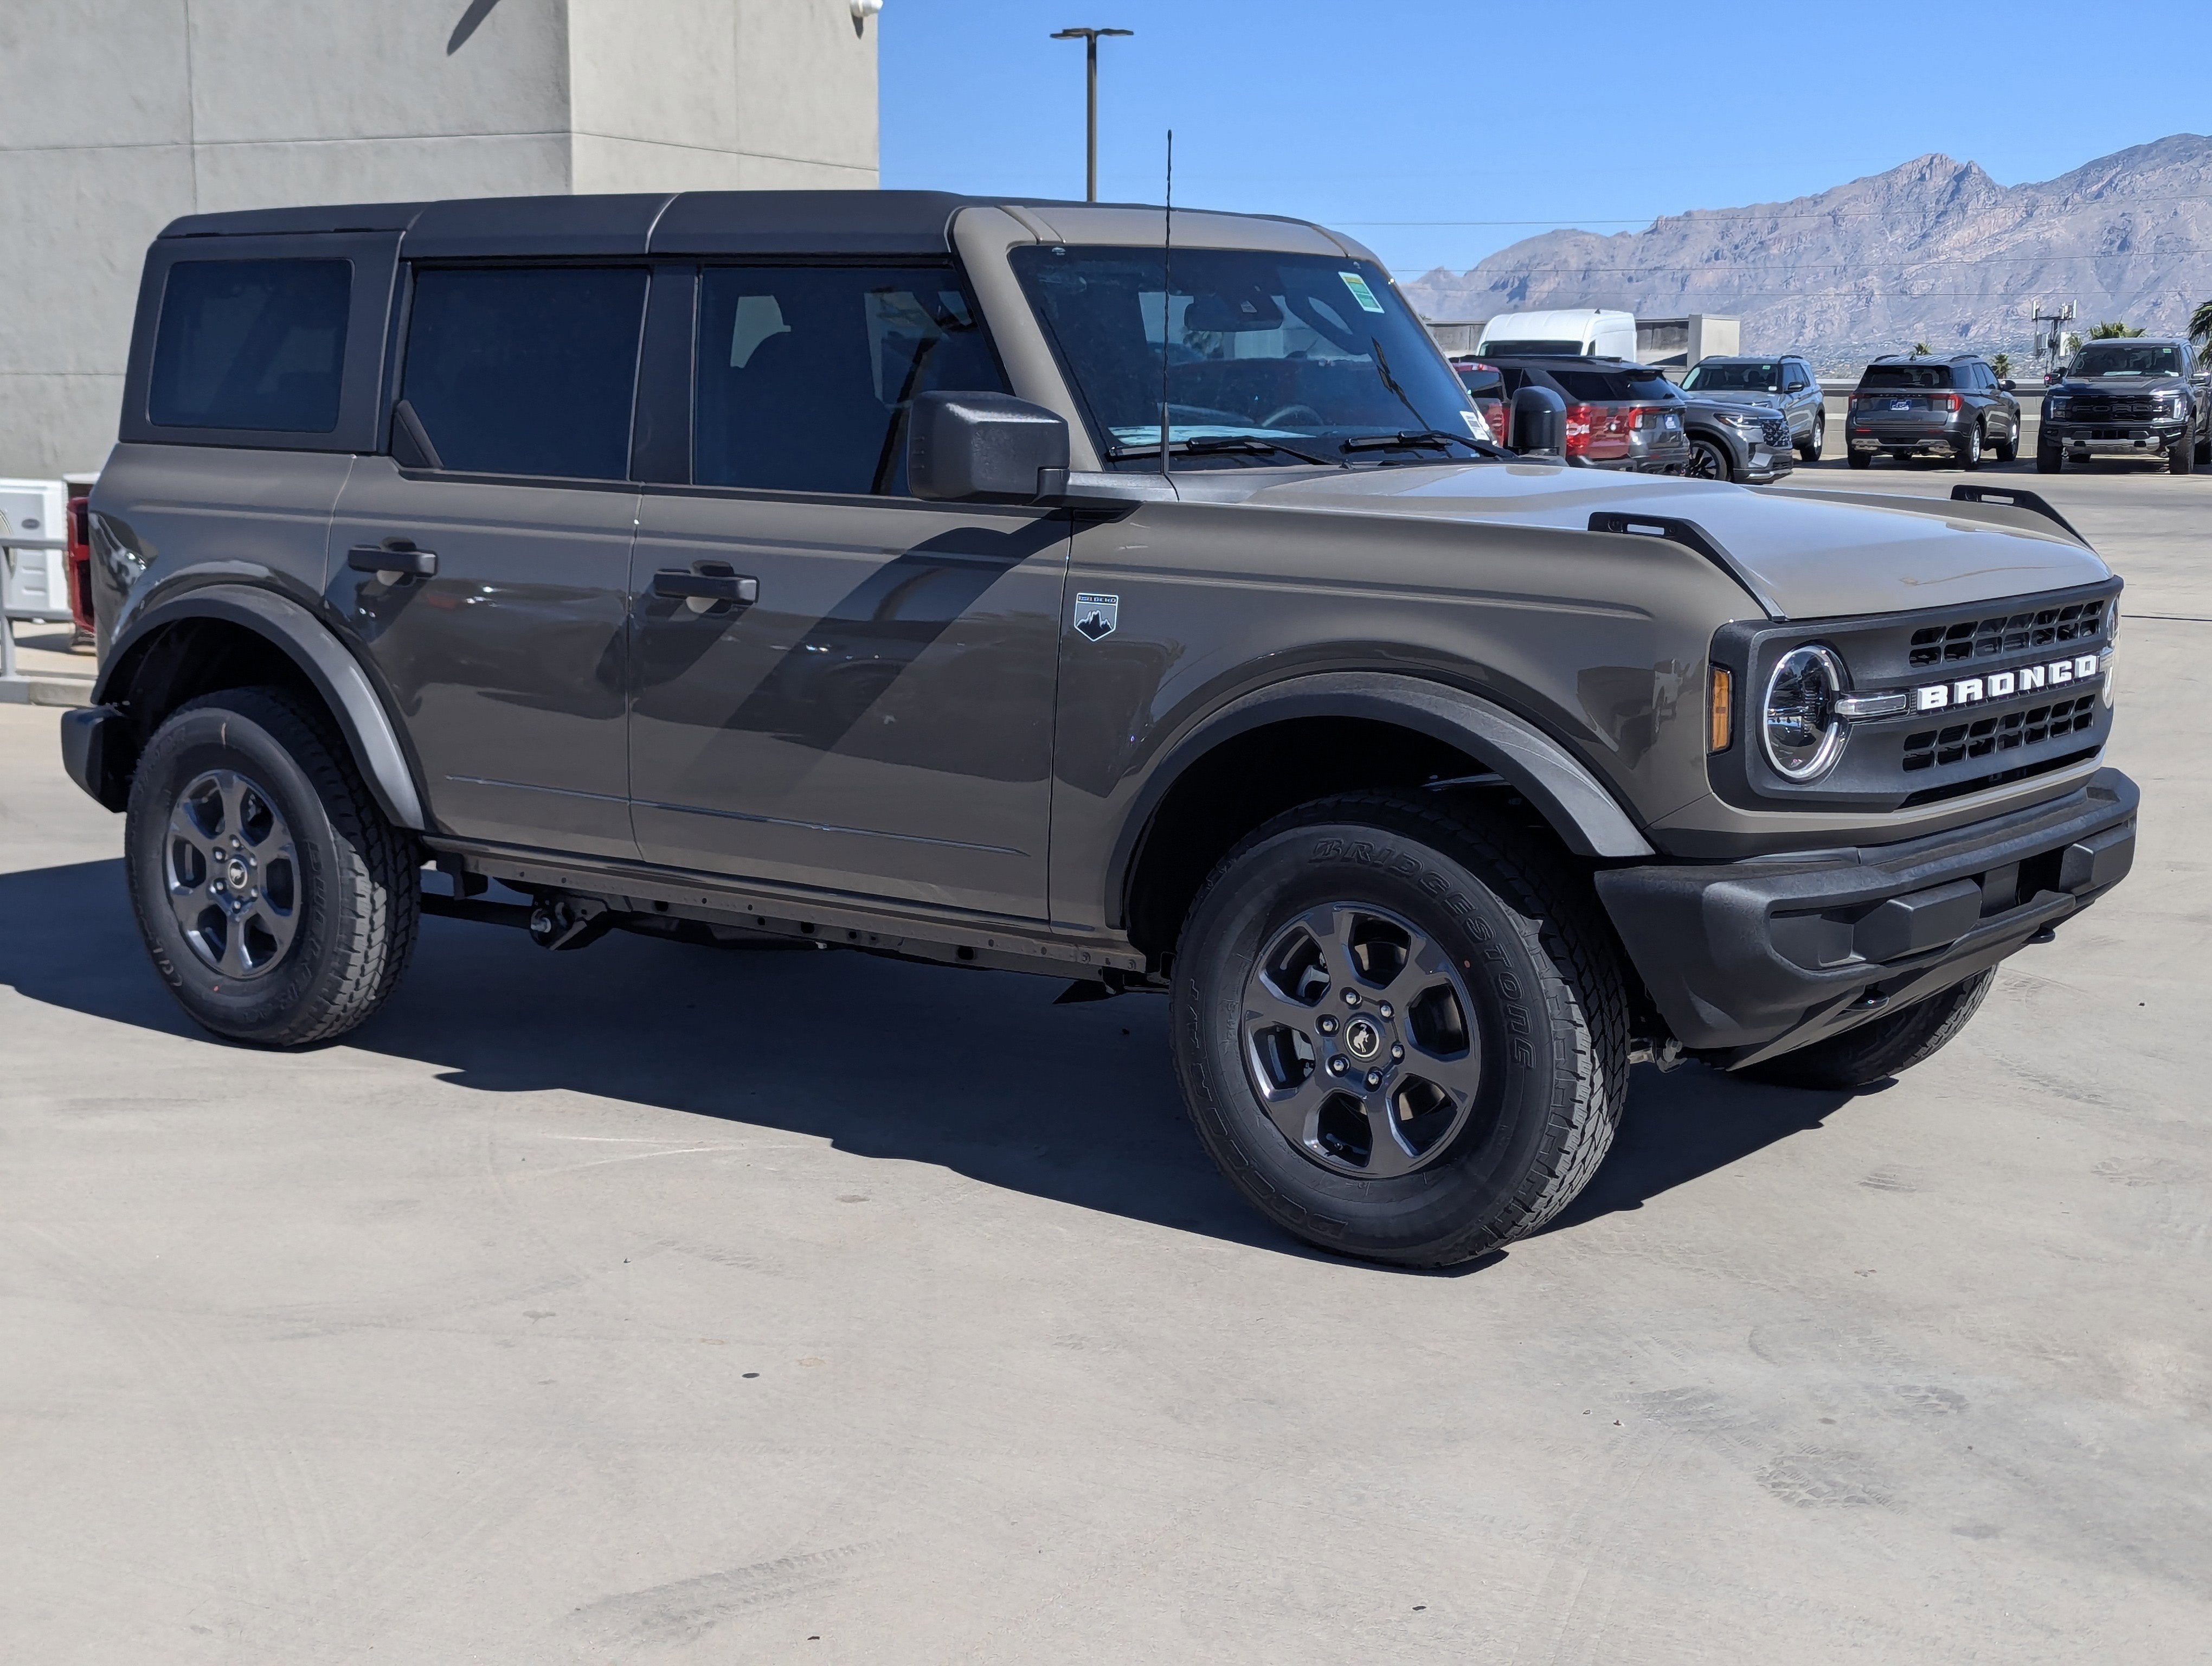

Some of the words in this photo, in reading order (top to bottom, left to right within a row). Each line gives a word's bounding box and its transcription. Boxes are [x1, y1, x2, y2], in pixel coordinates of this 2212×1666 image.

[2072, 403, 2153, 412] FORD
[1917, 654, 2098, 710] BRONCO
[1309, 838, 1537, 1068] BRIDGESTONE
